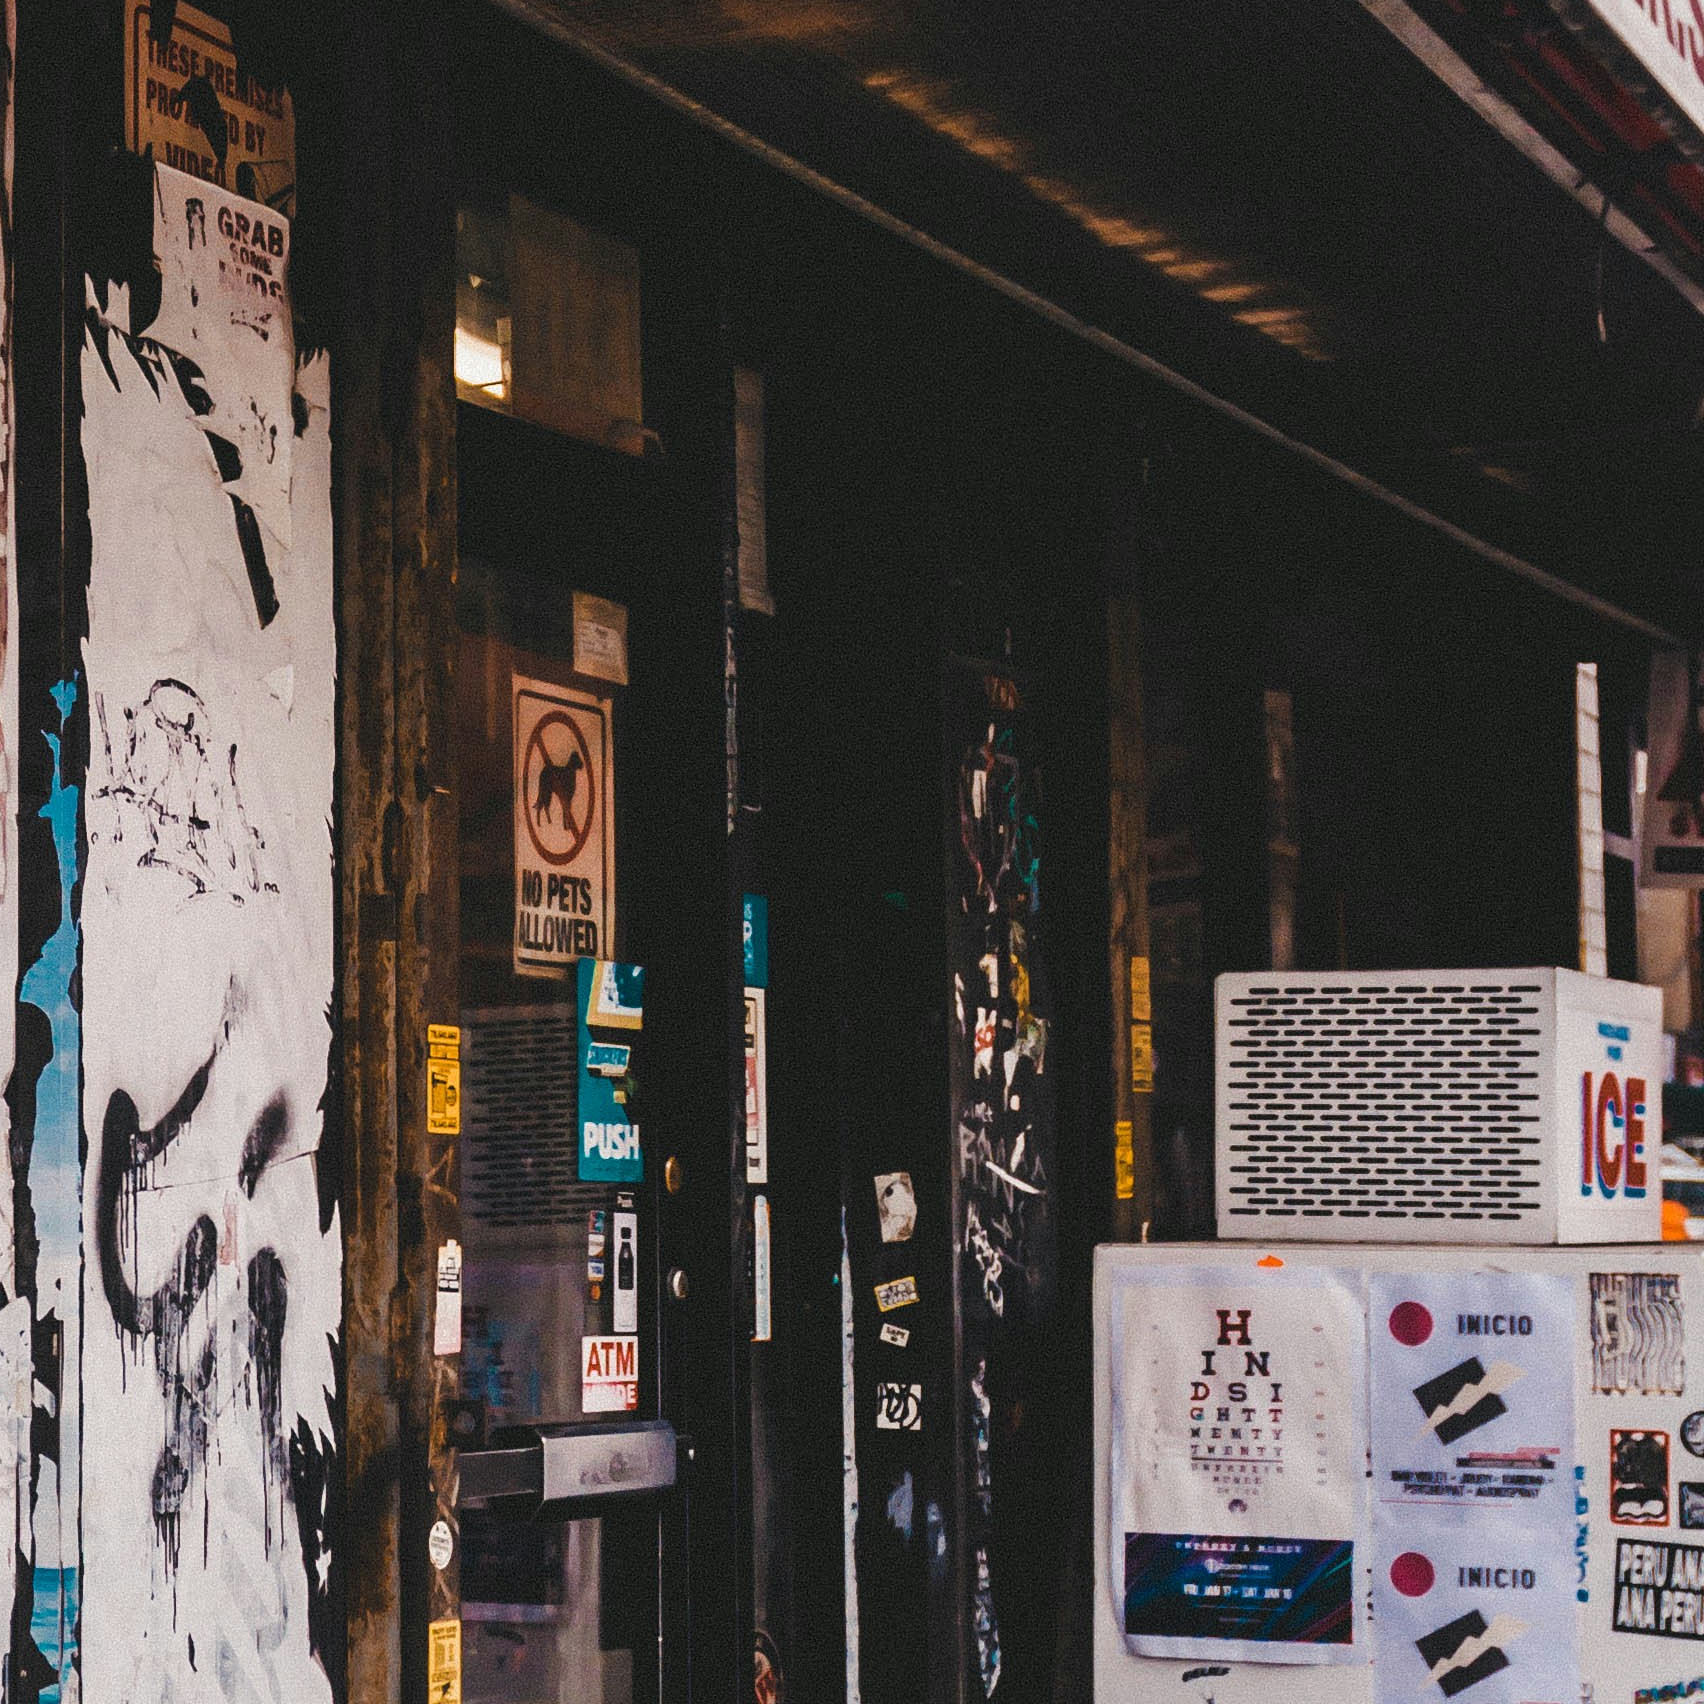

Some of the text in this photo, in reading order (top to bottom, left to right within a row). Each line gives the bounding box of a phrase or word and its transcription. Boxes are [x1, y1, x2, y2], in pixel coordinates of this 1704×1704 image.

[245, 124, 266, 158] BY
[217, 207, 284, 258] GRAB
[521, 868, 593, 916] NO PETS
[519, 914, 598, 956] ALLOWED
[583, 1122, 639, 1161] PUSH
[1581, 1070, 1647, 1194] ICE
[1216, 1309, 1252, 1346] H
[1457, 1314, 1534, 1337] INICIO
[585, 1341, 635, 1380] ATM
[1458, 1568, 1536, 1590] INICIO
